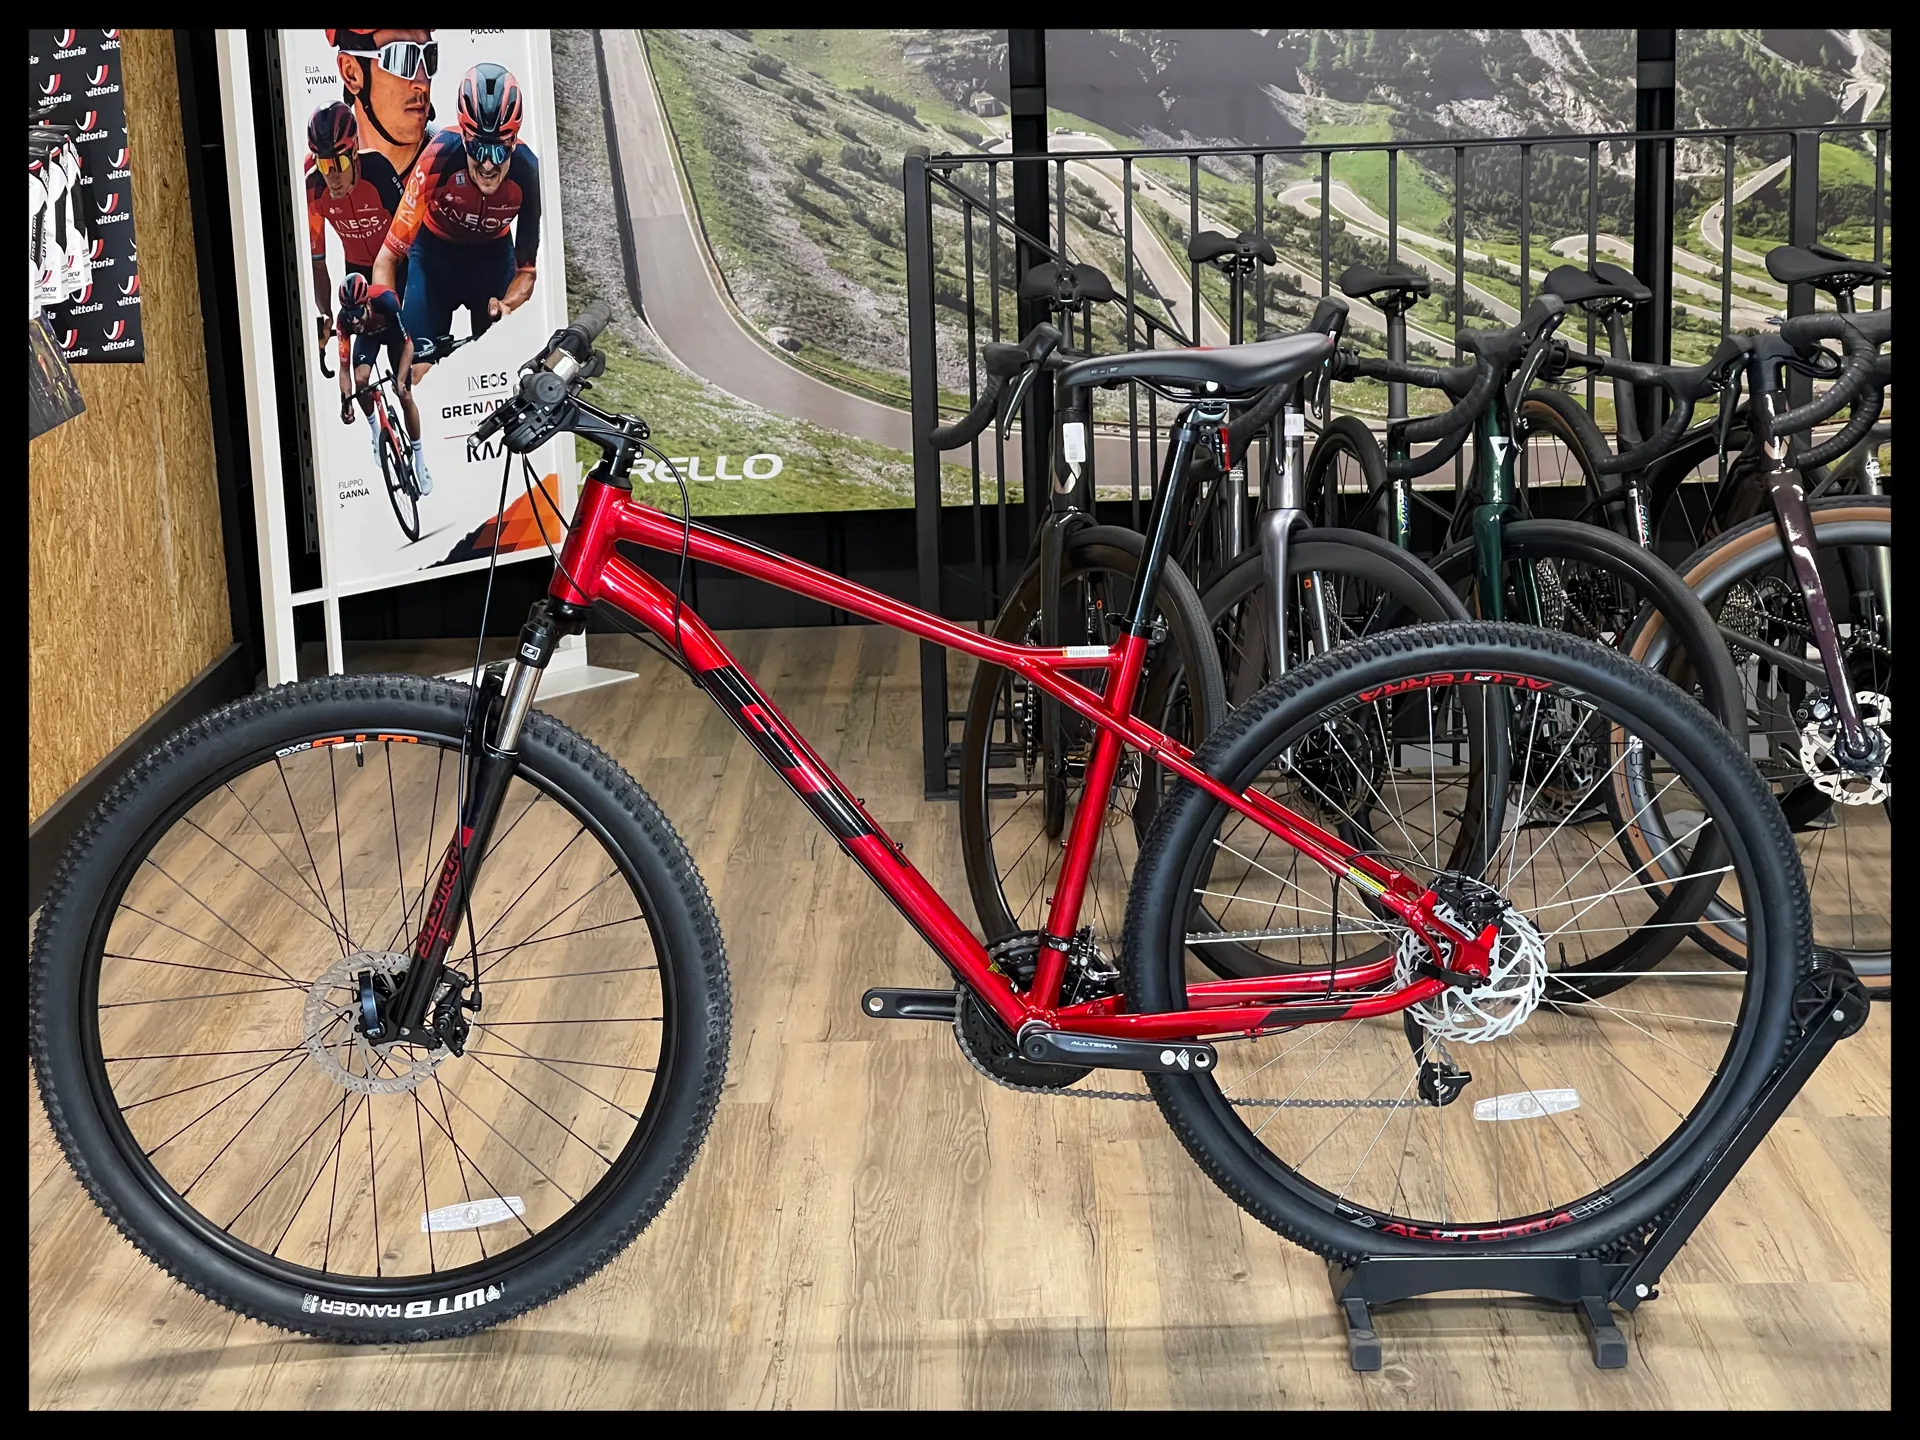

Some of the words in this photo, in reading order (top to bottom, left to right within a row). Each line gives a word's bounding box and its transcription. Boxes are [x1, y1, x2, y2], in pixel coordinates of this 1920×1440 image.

[53, 46, 87, 60] vittoria
[305, 65, 320, 74] ELIA
[306, 75, 337, 85] VIVIANI
[85, 84, 119, 97] vittoria
[38, 93, 72, 106] vittoria
[107, 169, 131, 180] vitto
[96, 212, 130, 225] vittoria
[335, 216, 380, 230] INEOS
[90, 257, 115, 269] ttoria
[70, 302, 103, 315] vittoria
[102, 338, 135, 352] vittoria
[63, 347, 88, 359] ttoria
[468, 372, 508, 391] INEOS
[442, 398, 508, 419] GRENAD
[577, 453, 784, 485] RELLO
[338, 478, 363, 489] FILIPPO
[339, 488, 370, 500] GANNA
[320, 1297, 401, 1319] RANGER
[404, 1287, 487, 1319] WTB
